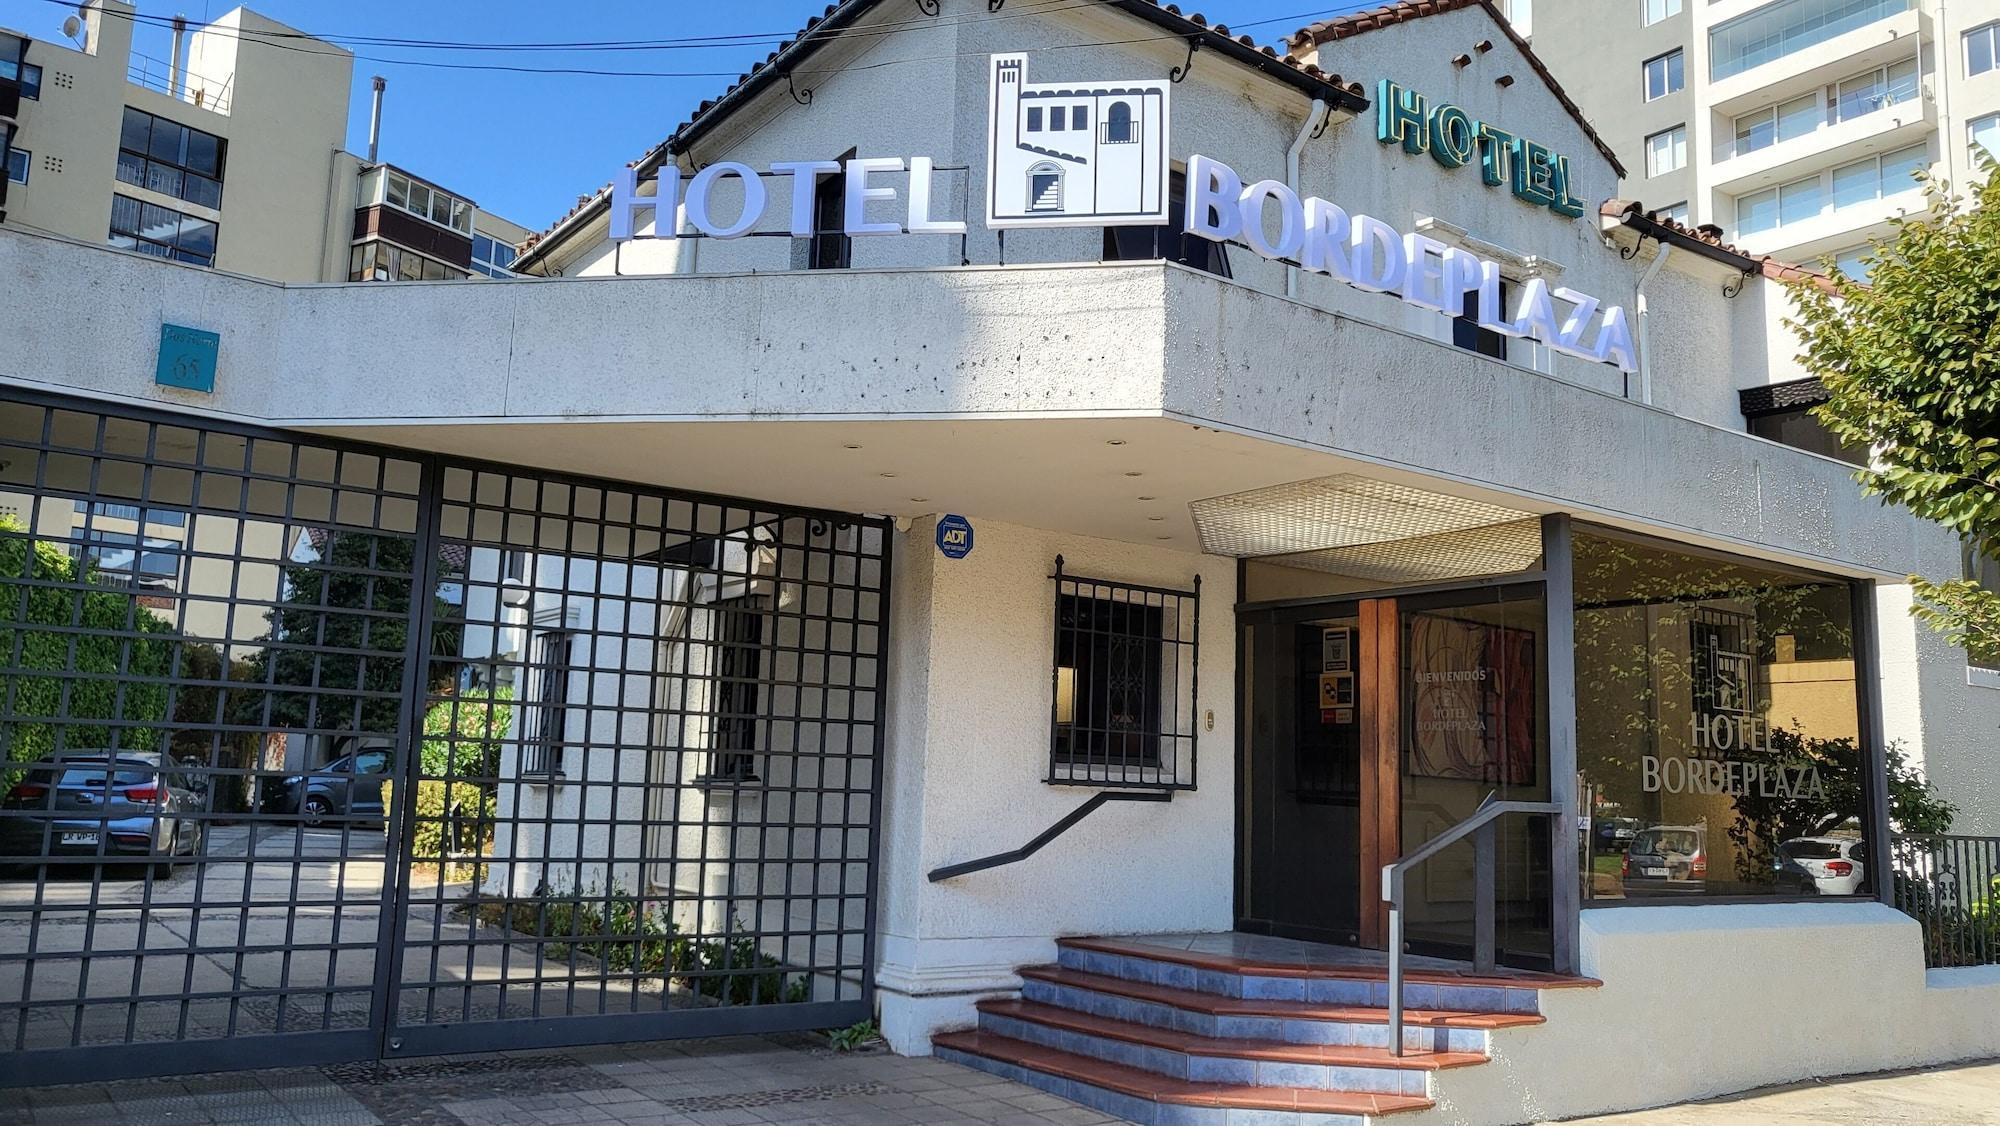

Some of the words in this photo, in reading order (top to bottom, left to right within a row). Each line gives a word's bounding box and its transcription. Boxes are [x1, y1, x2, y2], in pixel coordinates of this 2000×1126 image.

[1377, 78, 1586, 219] HOTEL
[608, 156, 967, 241] HOTEL
[1184, 154, 1638, 374] BORDEPLAZA
[943, 529, 967, 544] ADT
[1415, 670, 1487, 684] BIENVENIDOS
[1416, 720, 1487, 732] BORDEPLAZA
[1432, 708, 1468, 719] HOTEL
[1691, 711, 1780, 753] HOTEL
[1641, 754, 1828, 800] BORDEPLAZA
